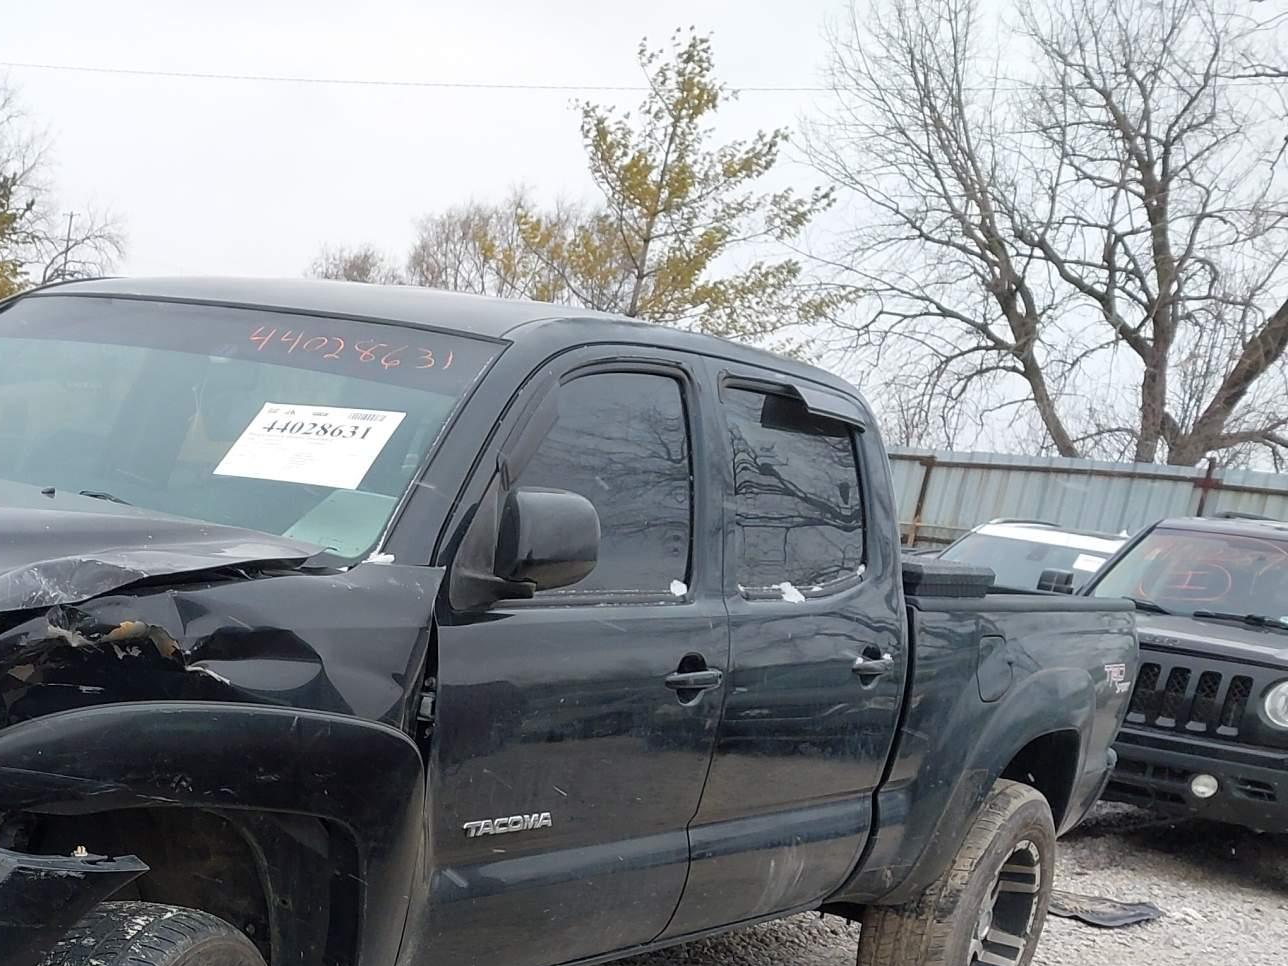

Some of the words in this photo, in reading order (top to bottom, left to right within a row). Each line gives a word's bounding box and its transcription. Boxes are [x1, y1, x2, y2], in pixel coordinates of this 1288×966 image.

[248, 326, 454, 370] 44028631
[263, 420, 373, 440] 44028631
[463, 812, 553, 838] TACOMA
